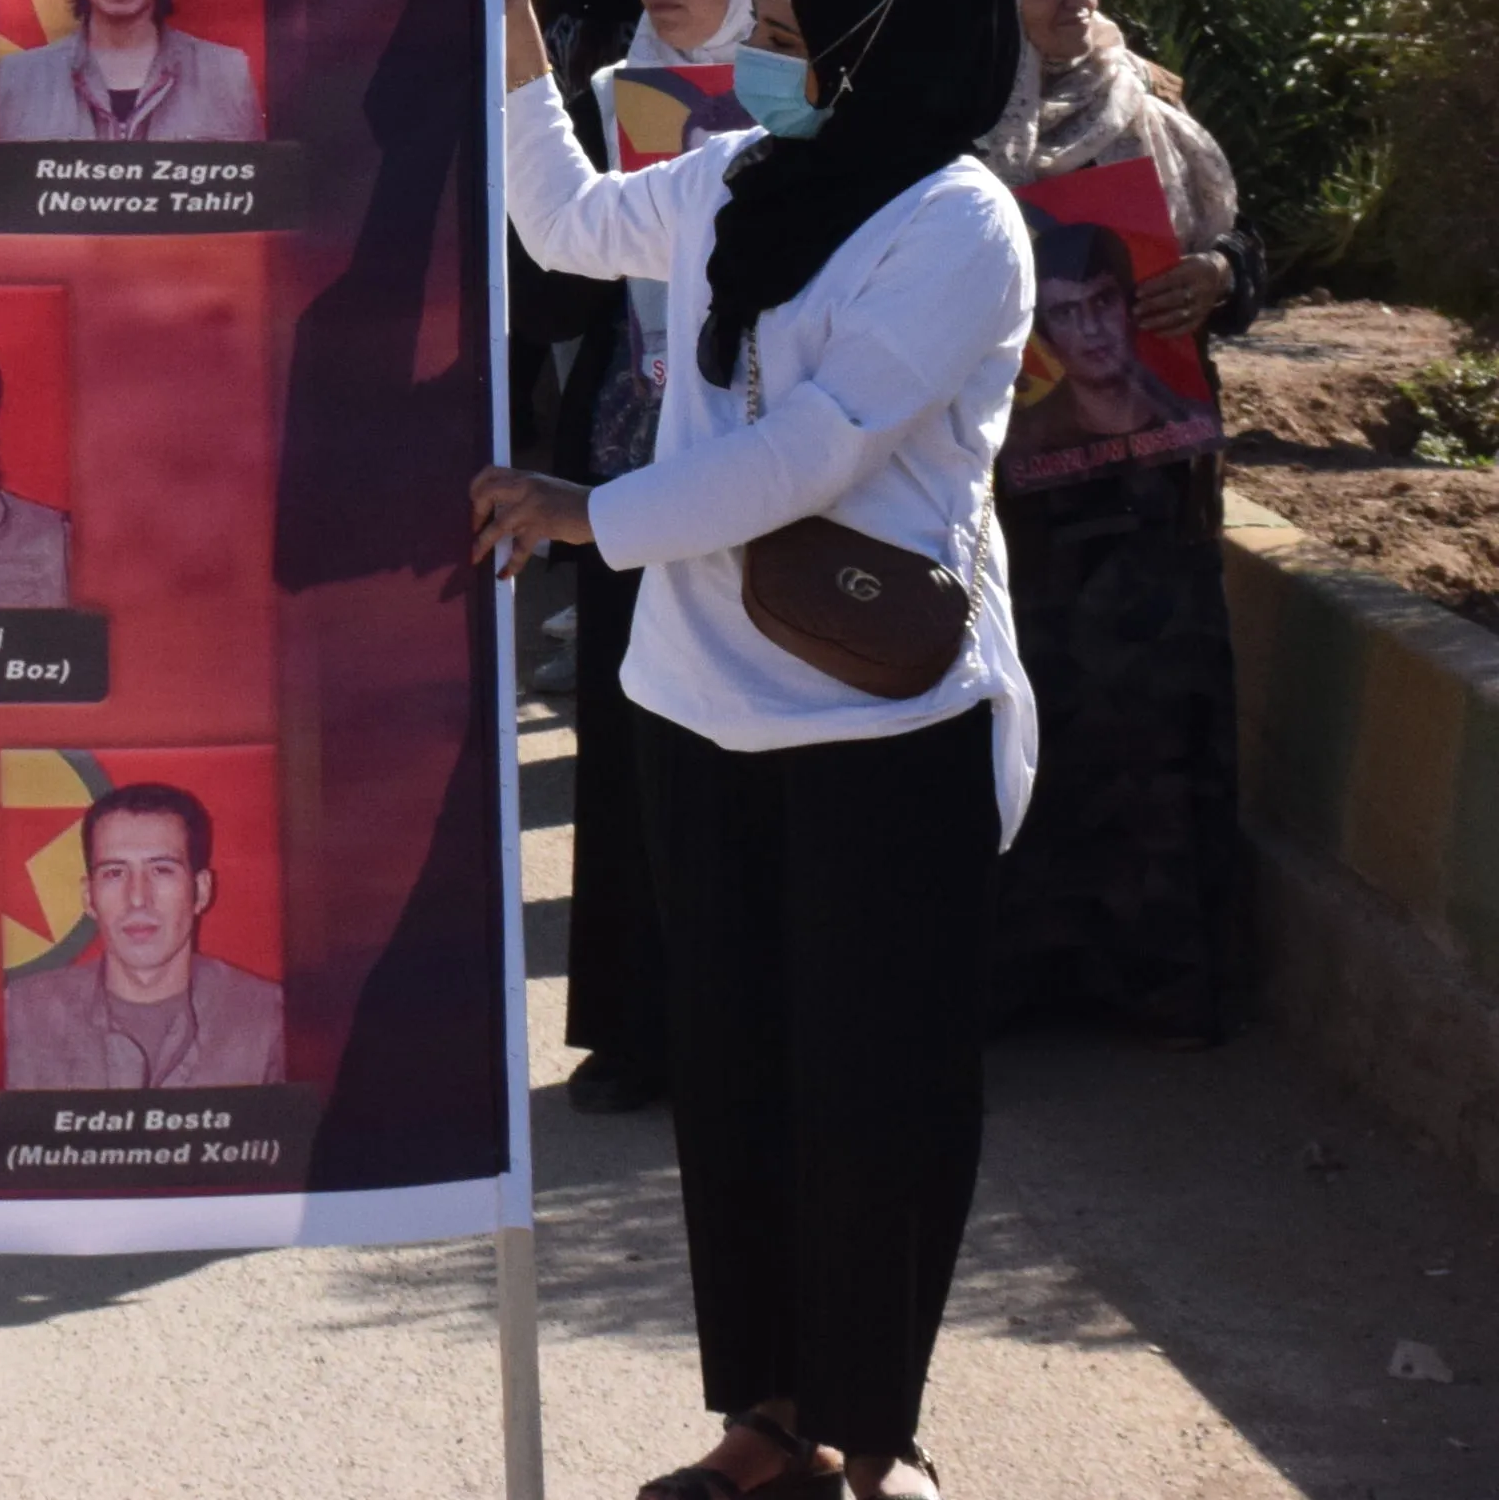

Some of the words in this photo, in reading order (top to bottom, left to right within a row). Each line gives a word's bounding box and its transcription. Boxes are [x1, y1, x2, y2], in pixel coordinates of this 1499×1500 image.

[152, 161, 255, 185] Zagros
[37, 192, 158, 215] (Newroz
[171, 193, 253, 214] Tahir)
[6, 660, 70, 683] Boz)
[55, 1111, 133, 1131] Erdal
[145, 1110, 231, 1130] Besta
[7, 1144, 190, 1170] (Muhammed
